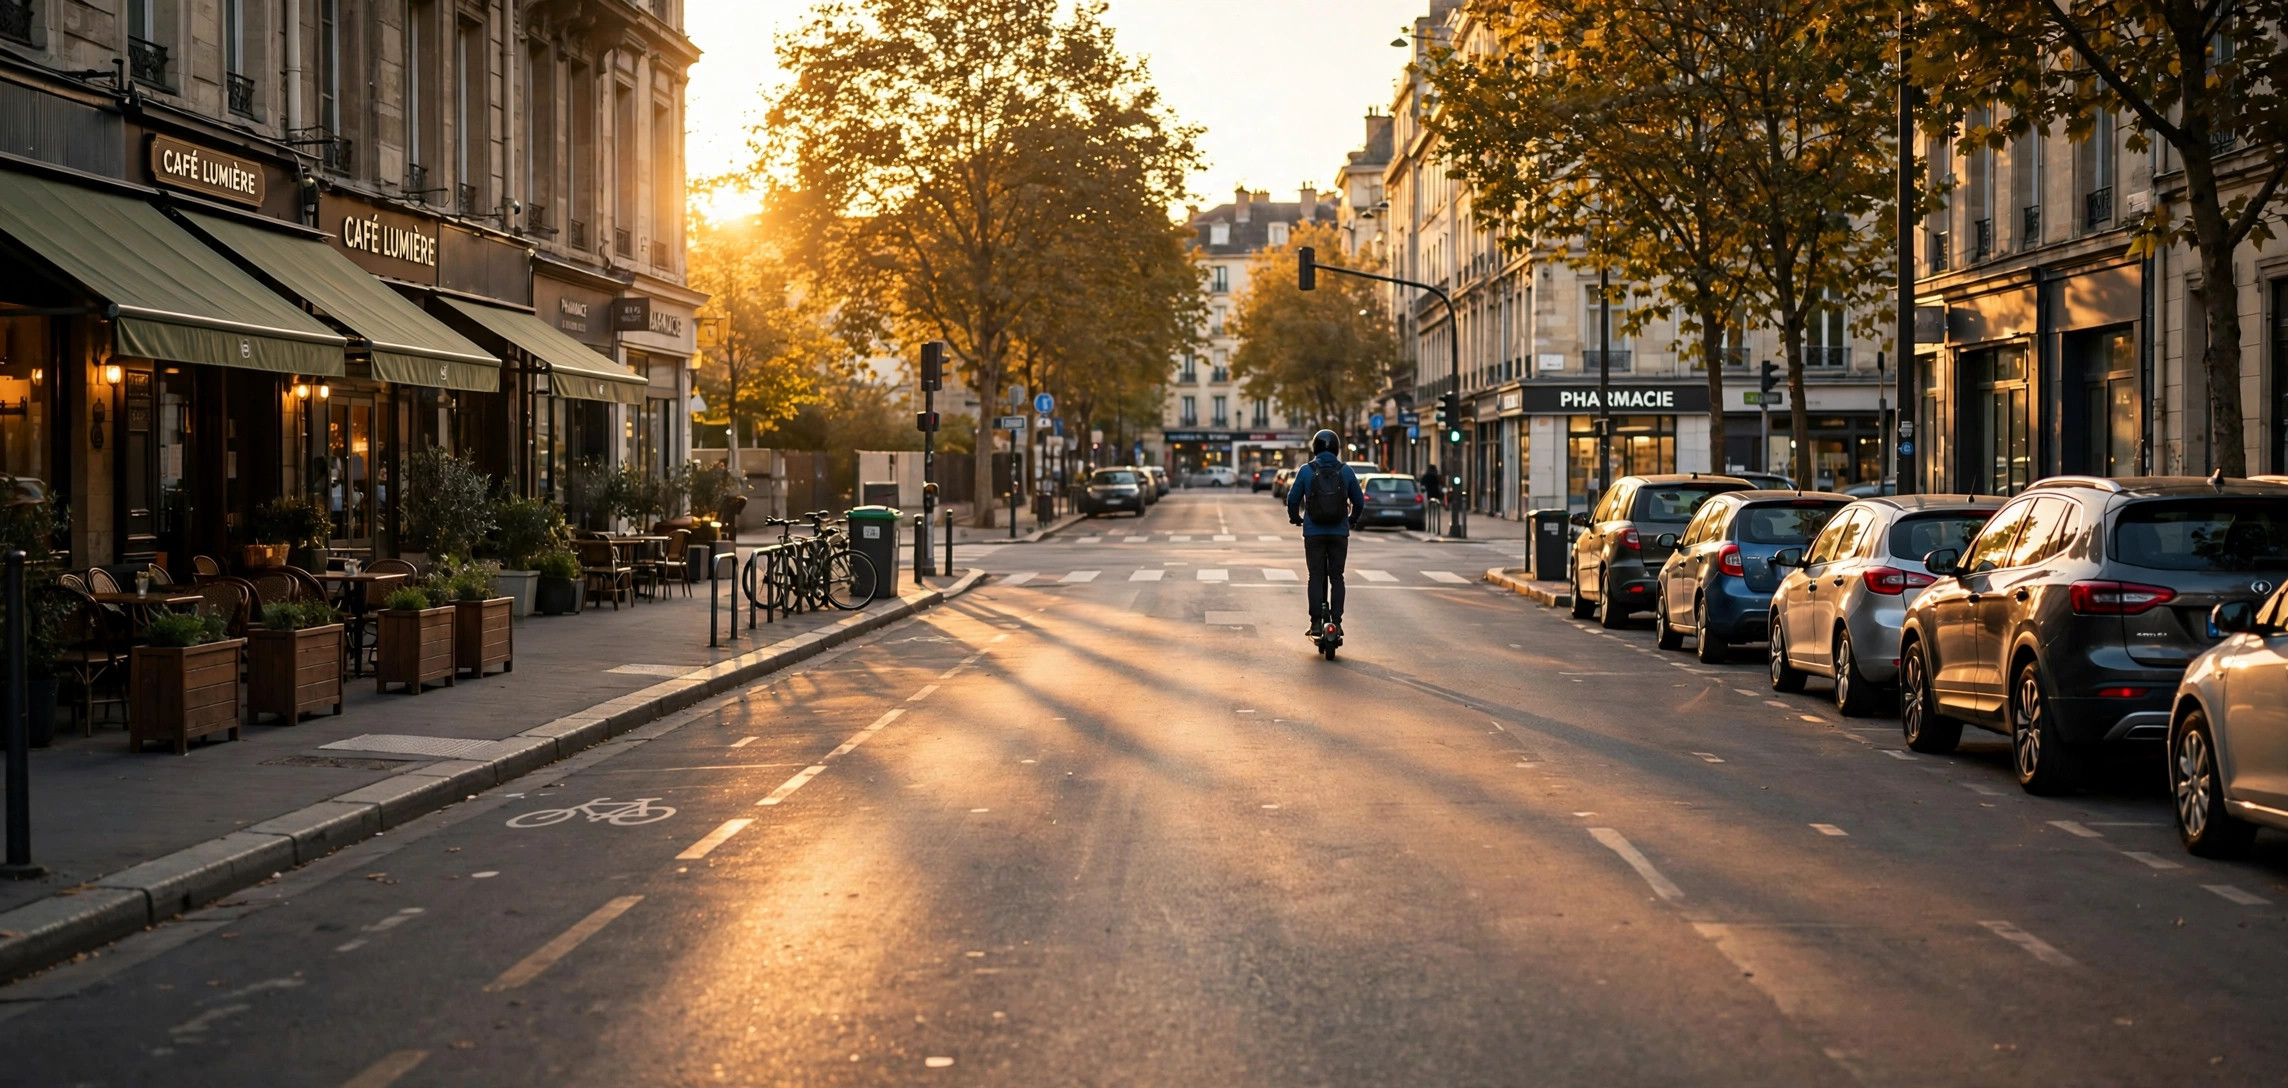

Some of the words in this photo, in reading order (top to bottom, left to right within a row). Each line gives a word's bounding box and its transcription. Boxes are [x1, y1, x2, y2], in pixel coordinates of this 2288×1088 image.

[163, 149, 199, 180] CAFÉ
[203, 160, 256, 195] LUMIÈRE
[344, 213, 379, 254] CAFÉ
[383, 224, 435, 267] LUMIÈRE
